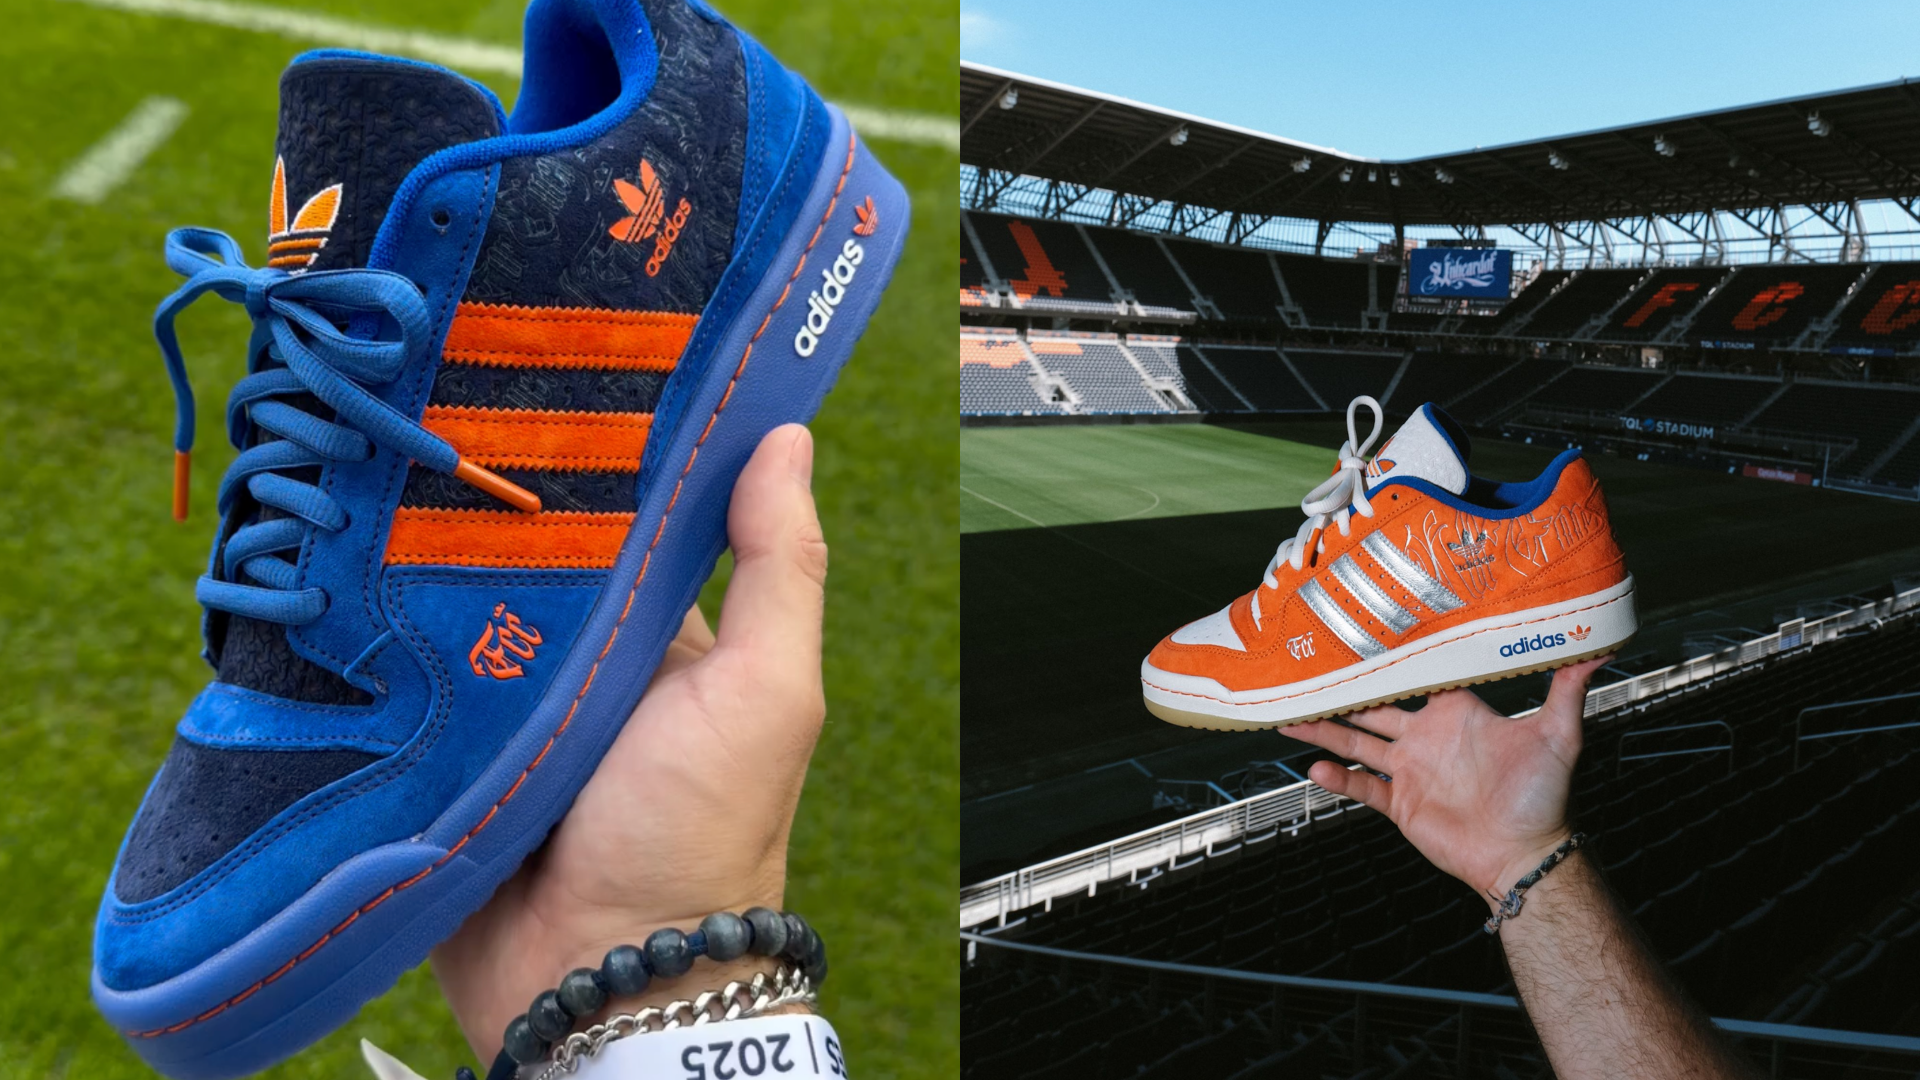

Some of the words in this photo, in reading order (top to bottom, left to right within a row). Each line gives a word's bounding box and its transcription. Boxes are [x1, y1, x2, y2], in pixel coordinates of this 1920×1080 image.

[645, 197, 692, 277] adidas
[794, 239, 864, 357] adidas
[1619, 416, 1643, 430] TQL
[1656, 420, 1714, 439] STADIUM
[1456, 554, 1495, 573] adidas
[1499, 630, 1566, 658] adidas
[681, 1033, 795, 1080] 2025
